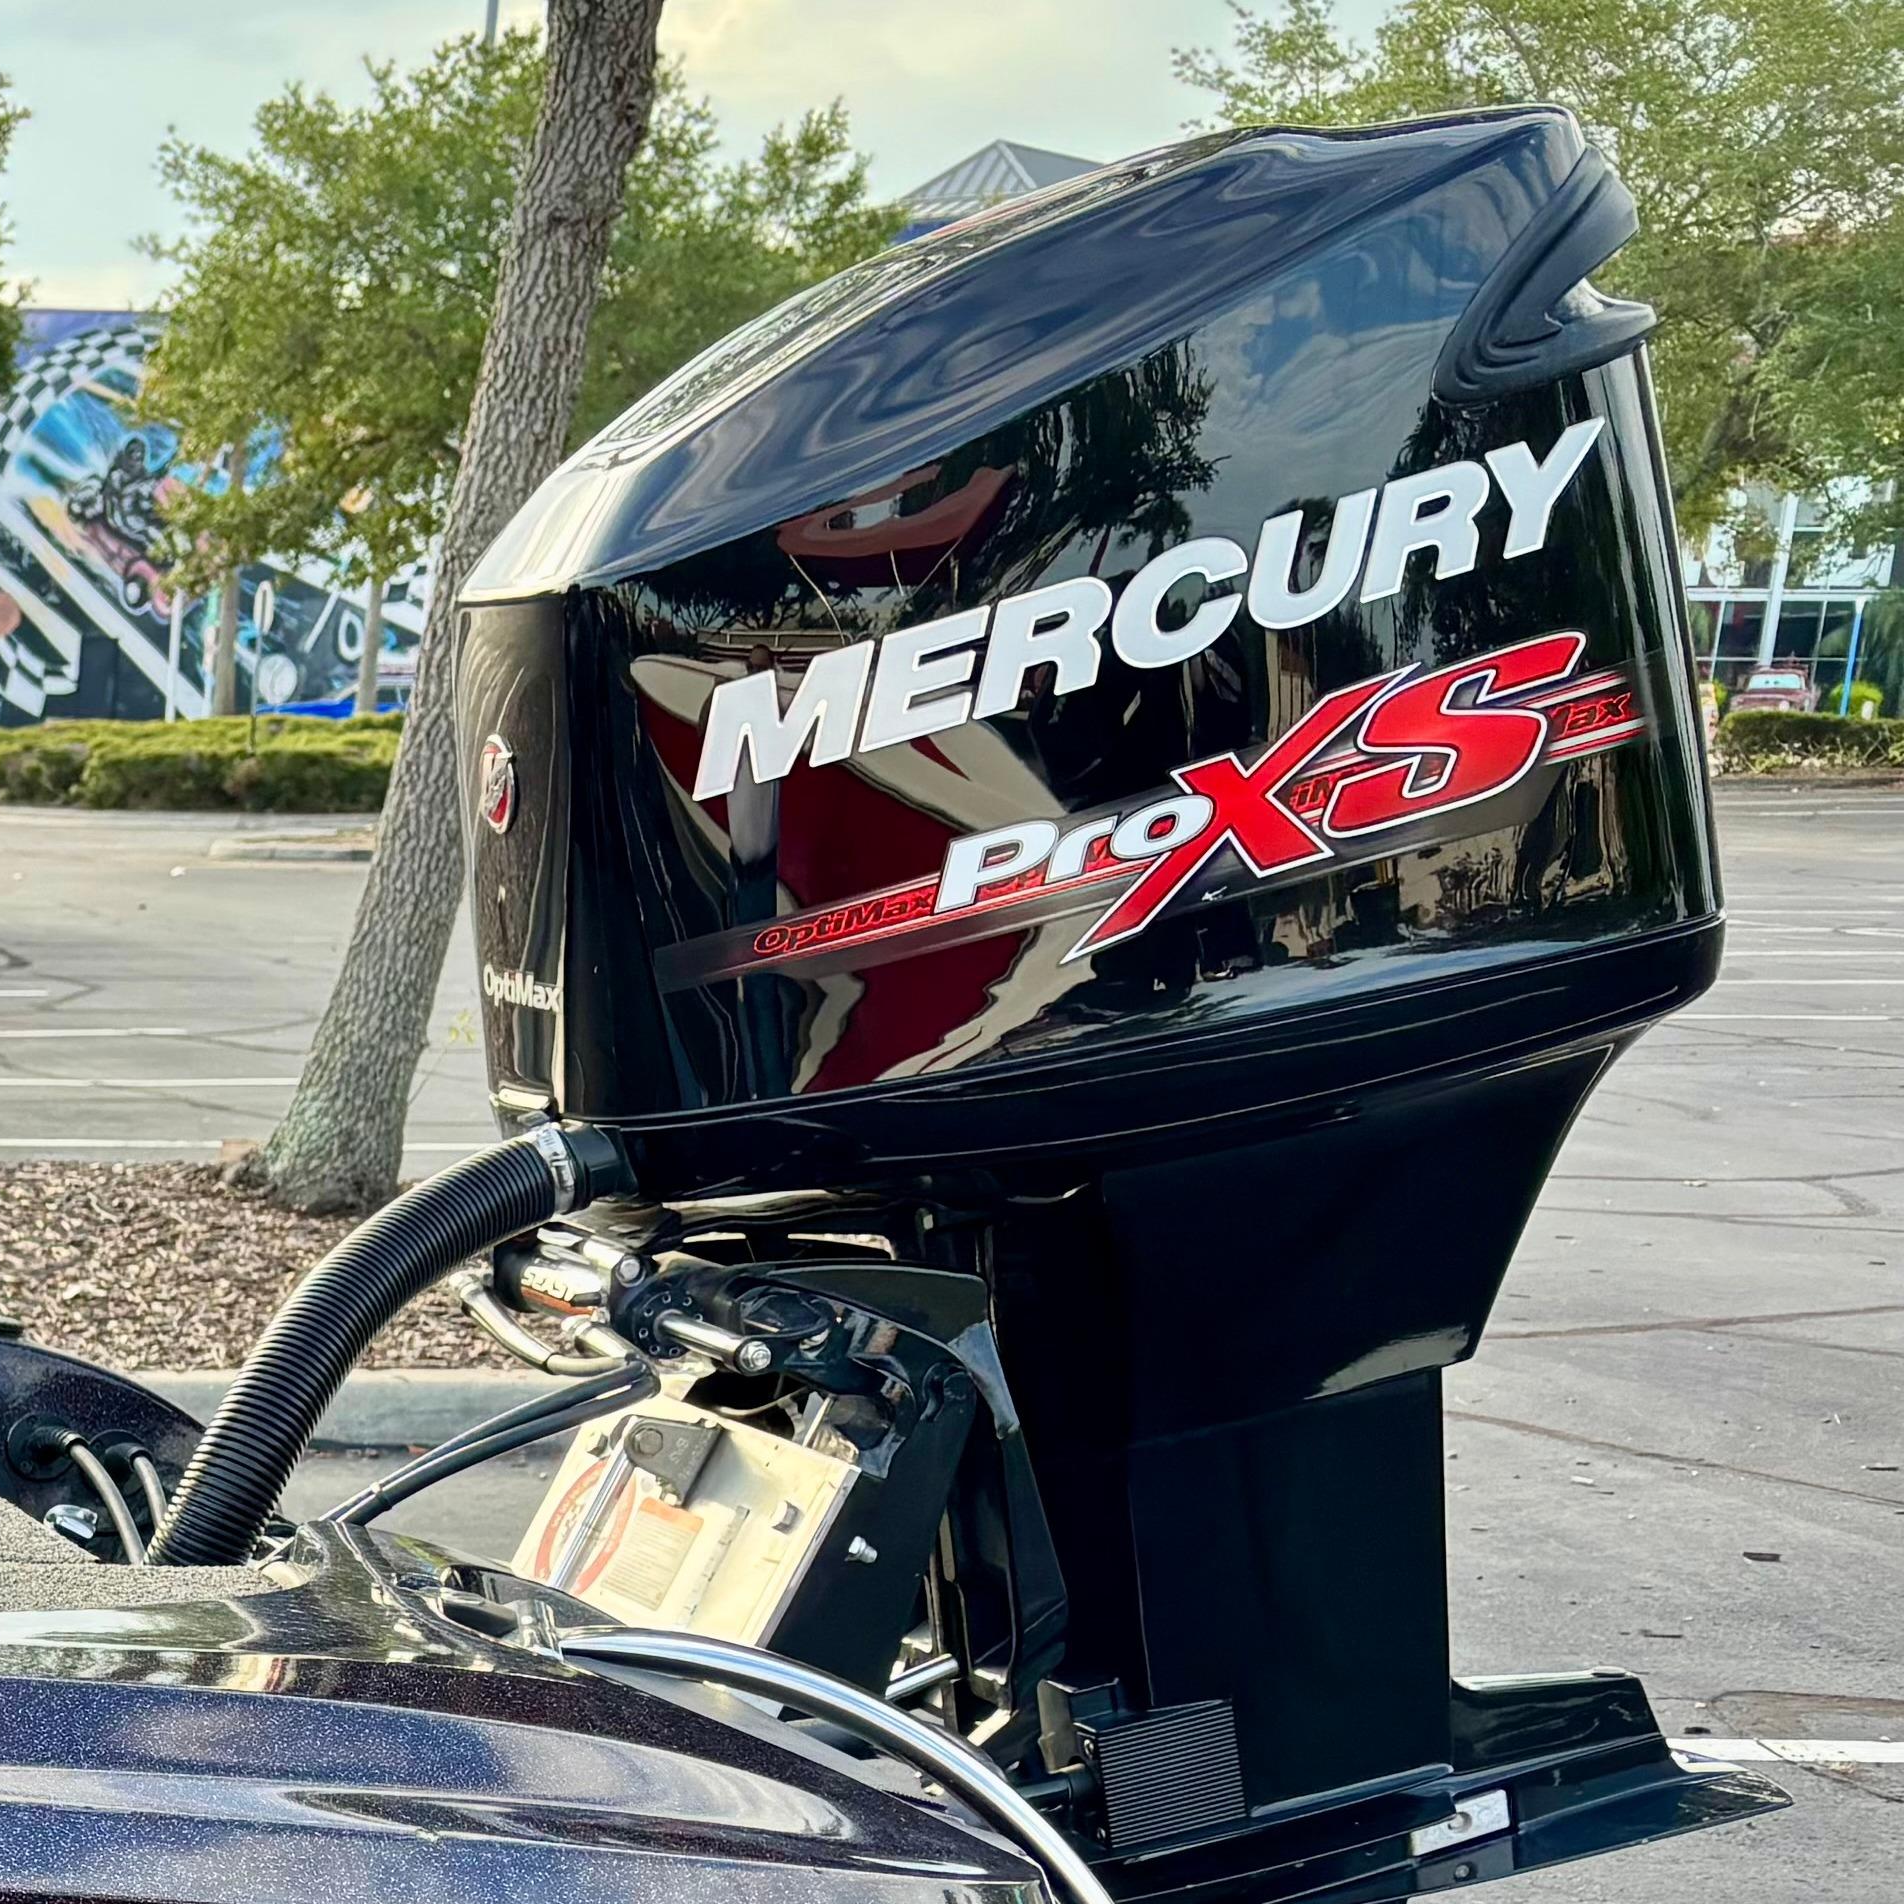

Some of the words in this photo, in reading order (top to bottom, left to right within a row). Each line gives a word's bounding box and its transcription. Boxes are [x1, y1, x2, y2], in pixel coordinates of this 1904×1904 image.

[691, 416, 1605, 801] MERCURY
[753, 886, 936, 955] OptiMax
[482, 963, 563, 1013] OptiMax
